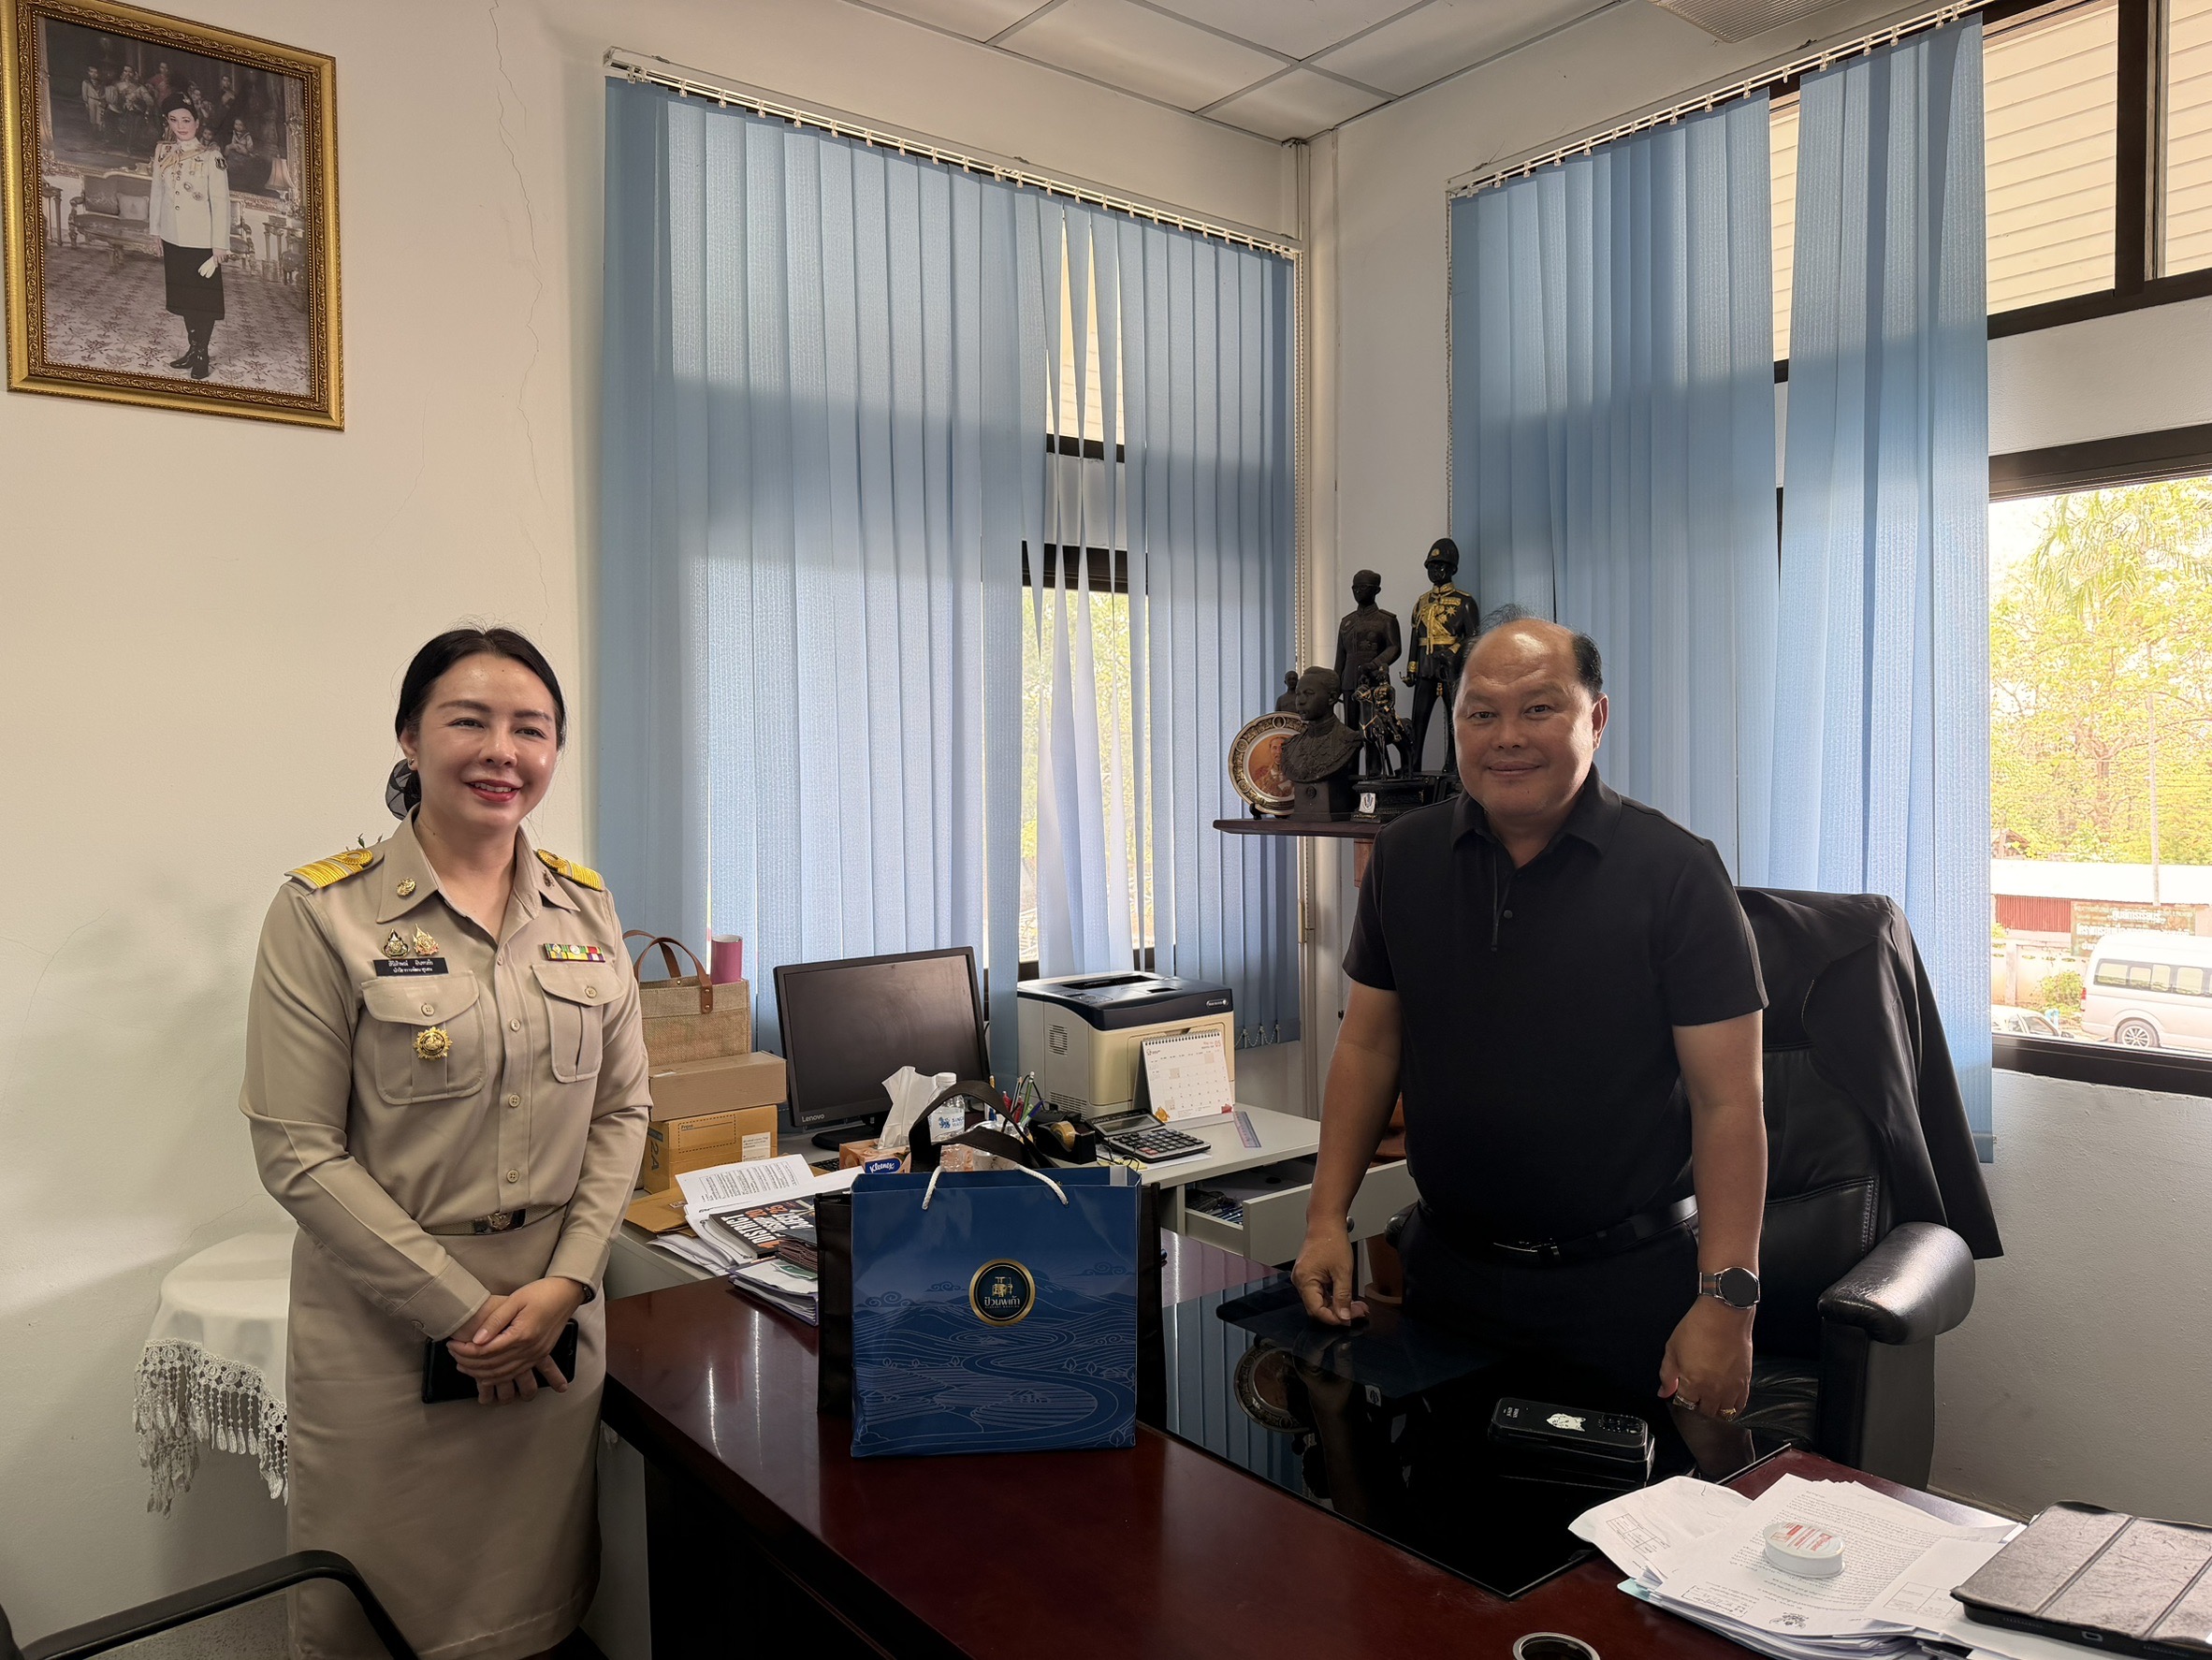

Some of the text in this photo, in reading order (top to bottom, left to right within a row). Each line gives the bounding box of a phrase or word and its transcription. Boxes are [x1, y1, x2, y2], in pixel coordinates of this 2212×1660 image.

[801, 1114, 825, 1123] Lenovo
[869, 1162, 895, 1173] Kleenex
[719, 1213, 778, 1244] DISTRICT
